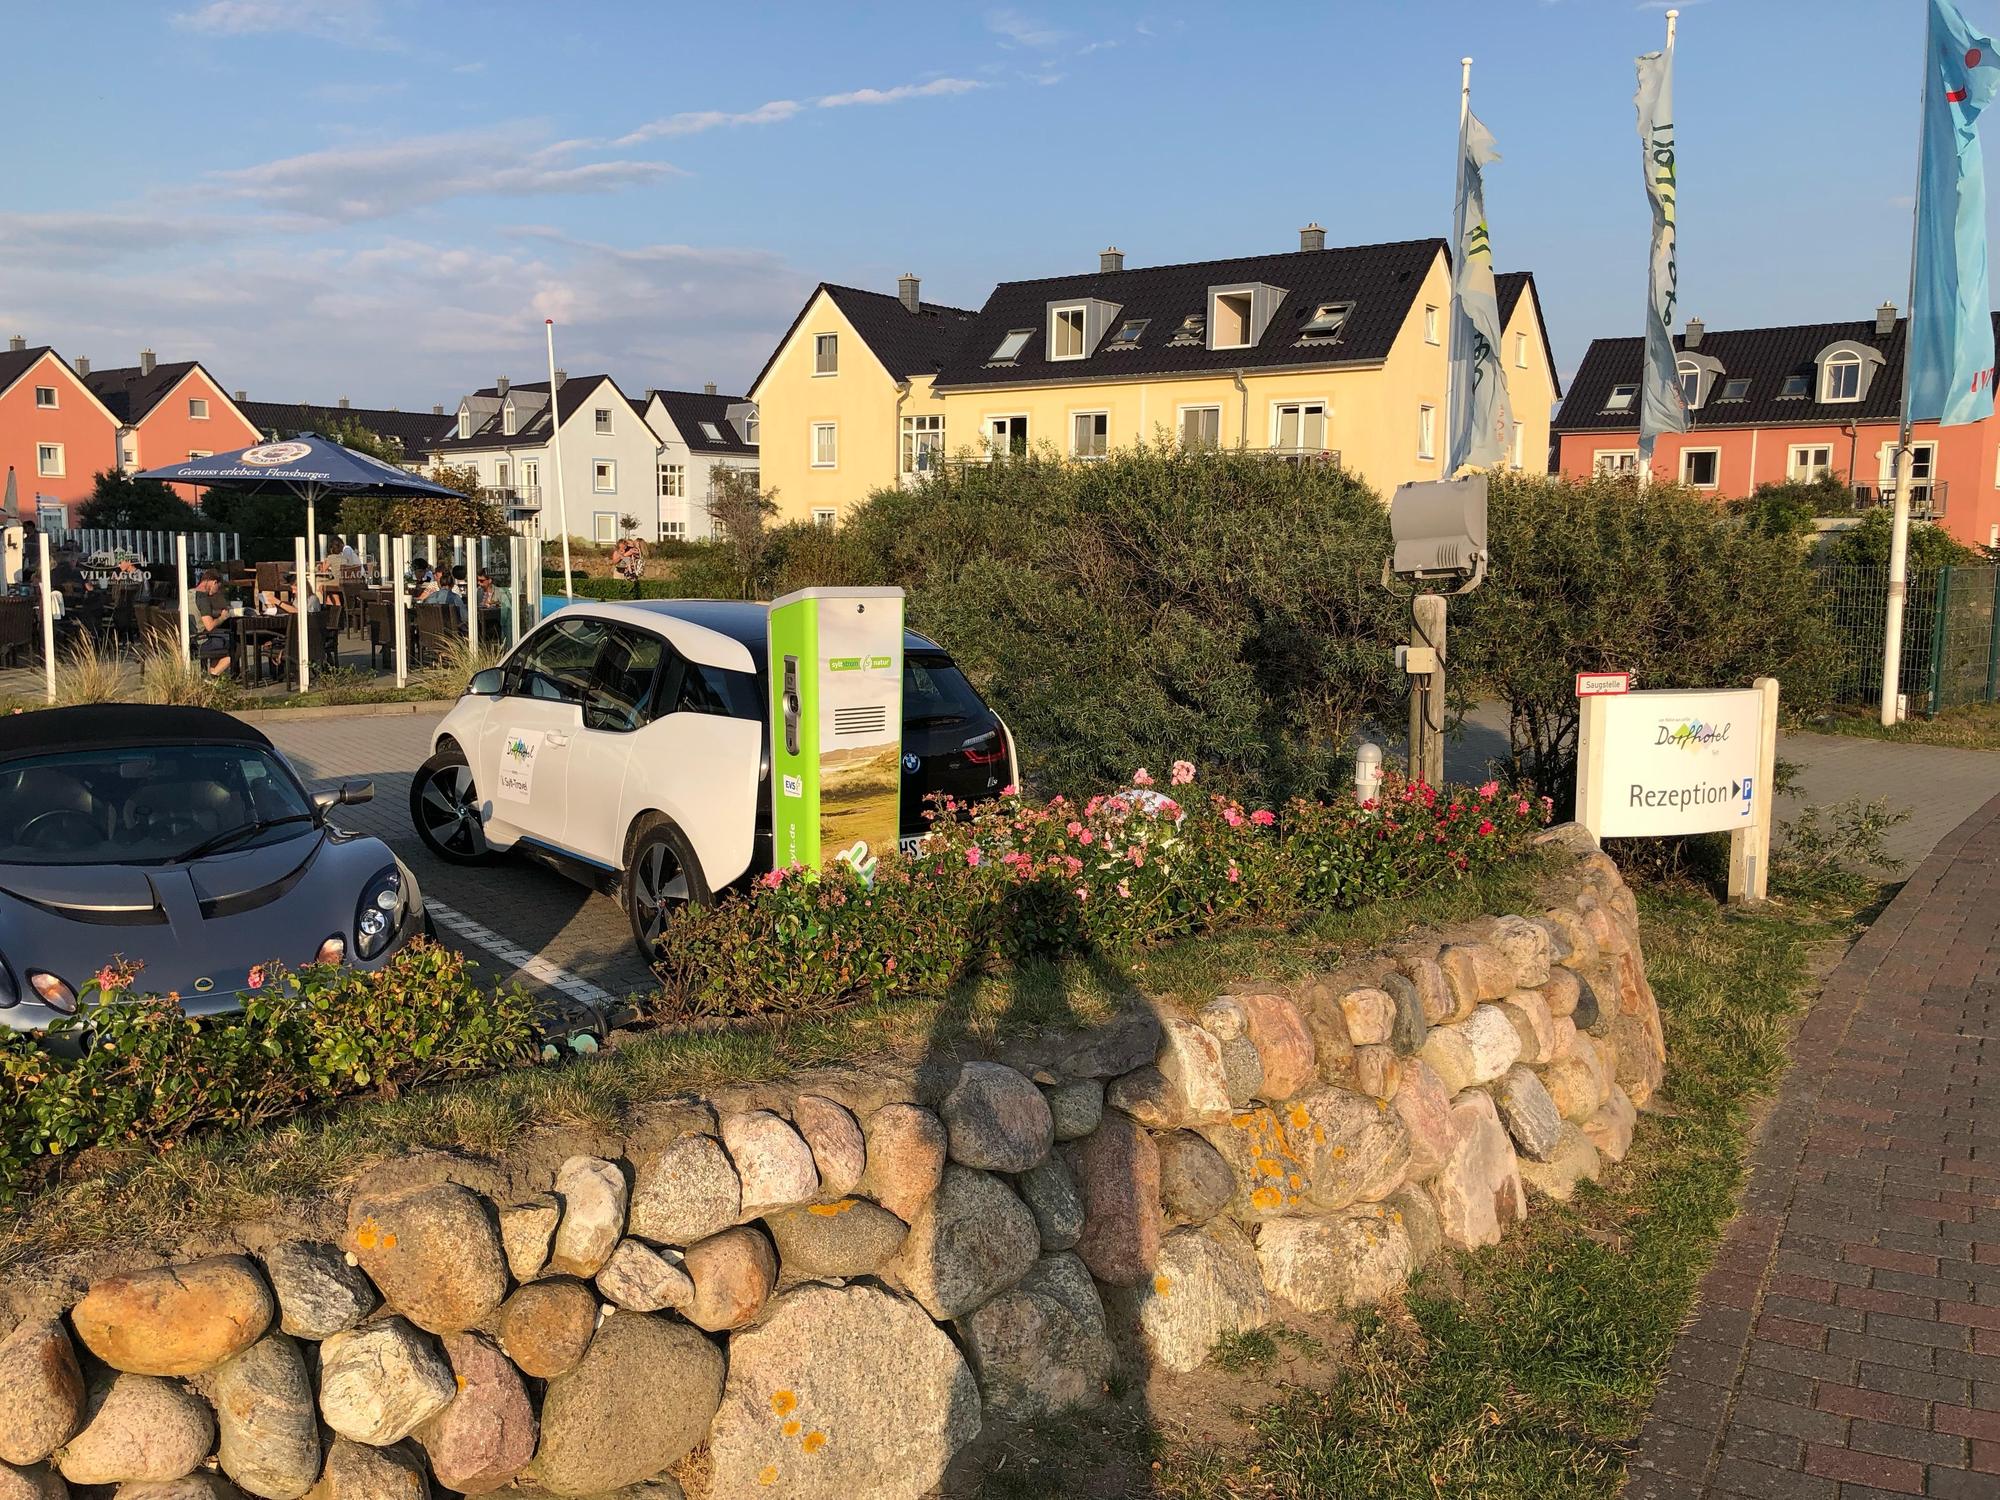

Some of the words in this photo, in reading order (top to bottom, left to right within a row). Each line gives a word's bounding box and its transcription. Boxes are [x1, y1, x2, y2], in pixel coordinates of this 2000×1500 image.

[177, 467, 218, 477] Genuss
[219, 467, 262, 477] erleben.
[265, 468, 331, 480] Flensburger.
[1585, 680, 1621, 691] Saugstelle
[1654, 722, 1731, 751] Dorfhotel
[1629, 781, 1727, 812] Rezeption
